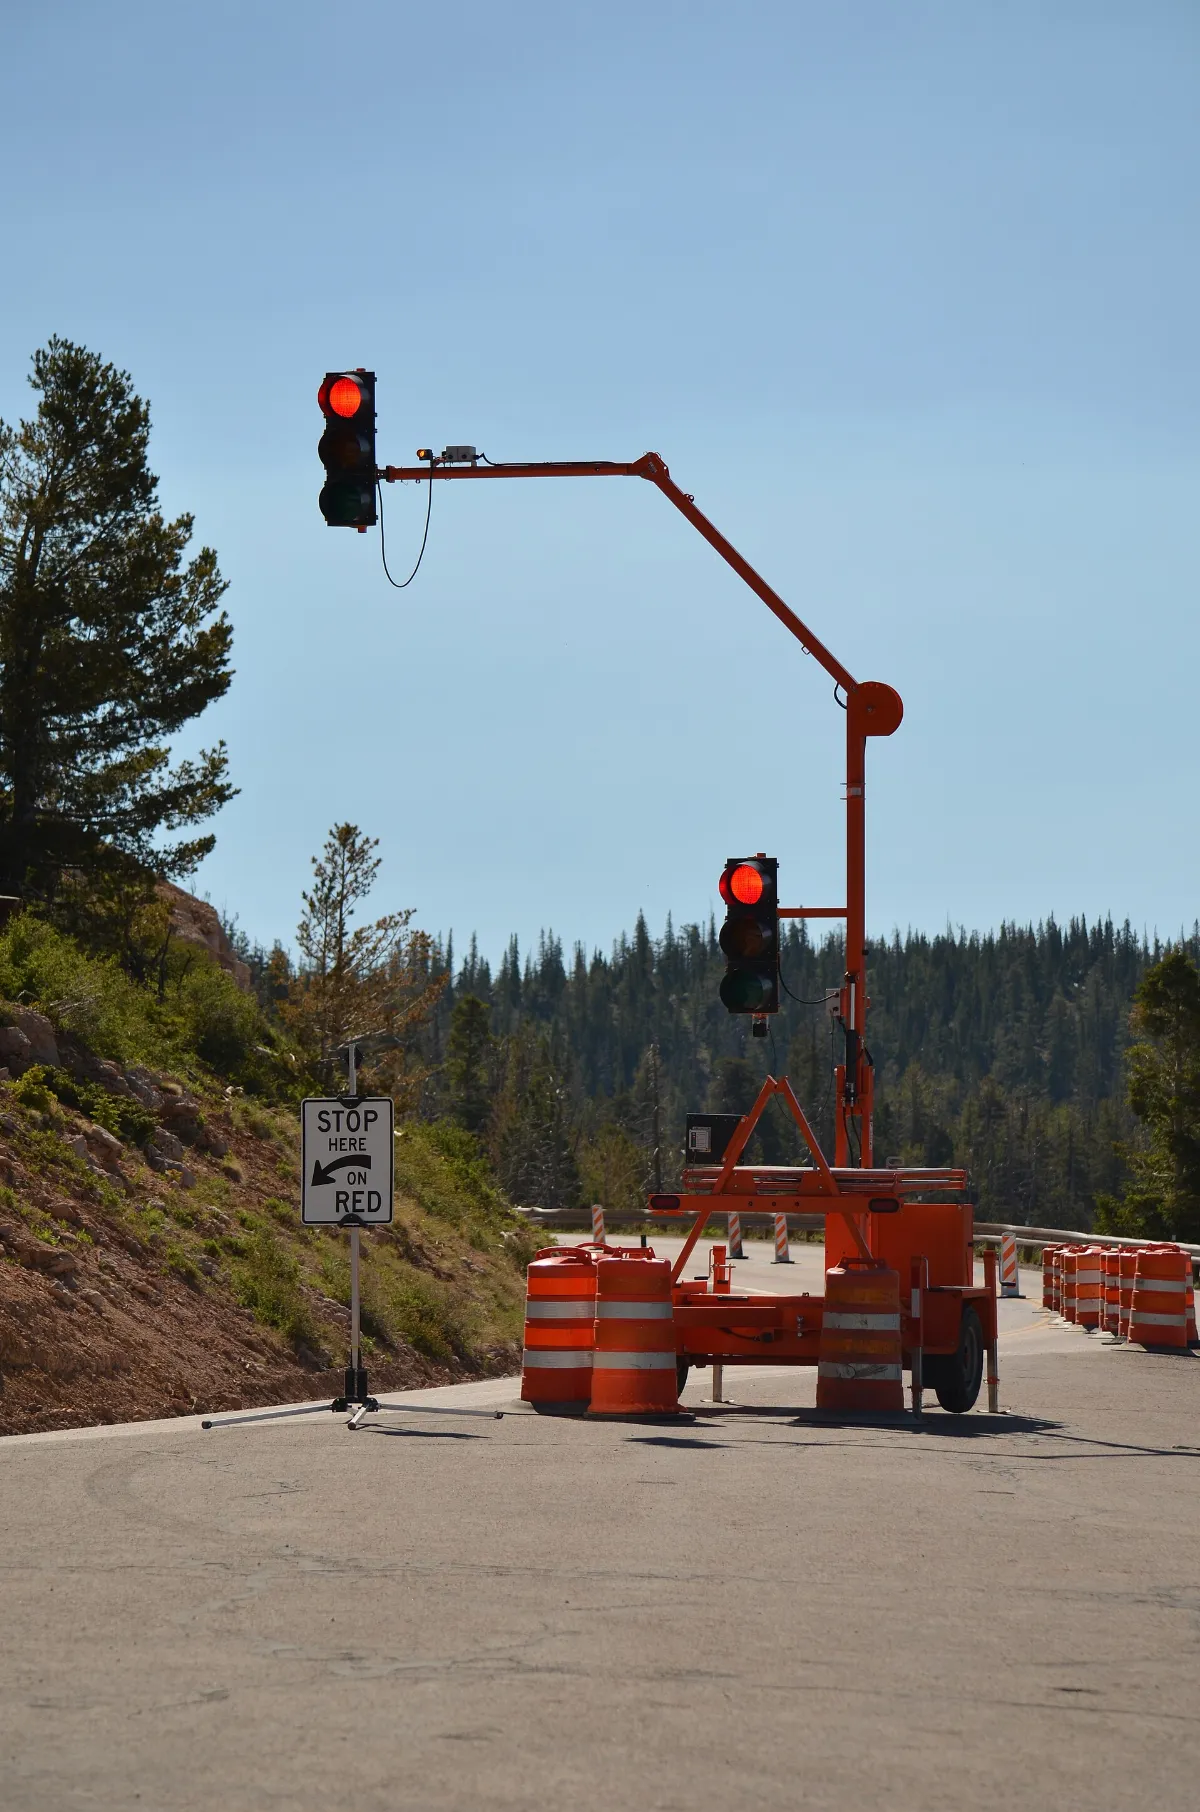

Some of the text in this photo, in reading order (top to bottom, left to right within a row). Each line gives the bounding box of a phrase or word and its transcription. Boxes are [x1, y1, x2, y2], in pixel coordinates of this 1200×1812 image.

[317, 1109, 379, 1133] STOP
[328, 1137, 367, 1151] HERE
[347, 1171, 367, 1185] ON
[335, 1190, 382, 1213] RED
